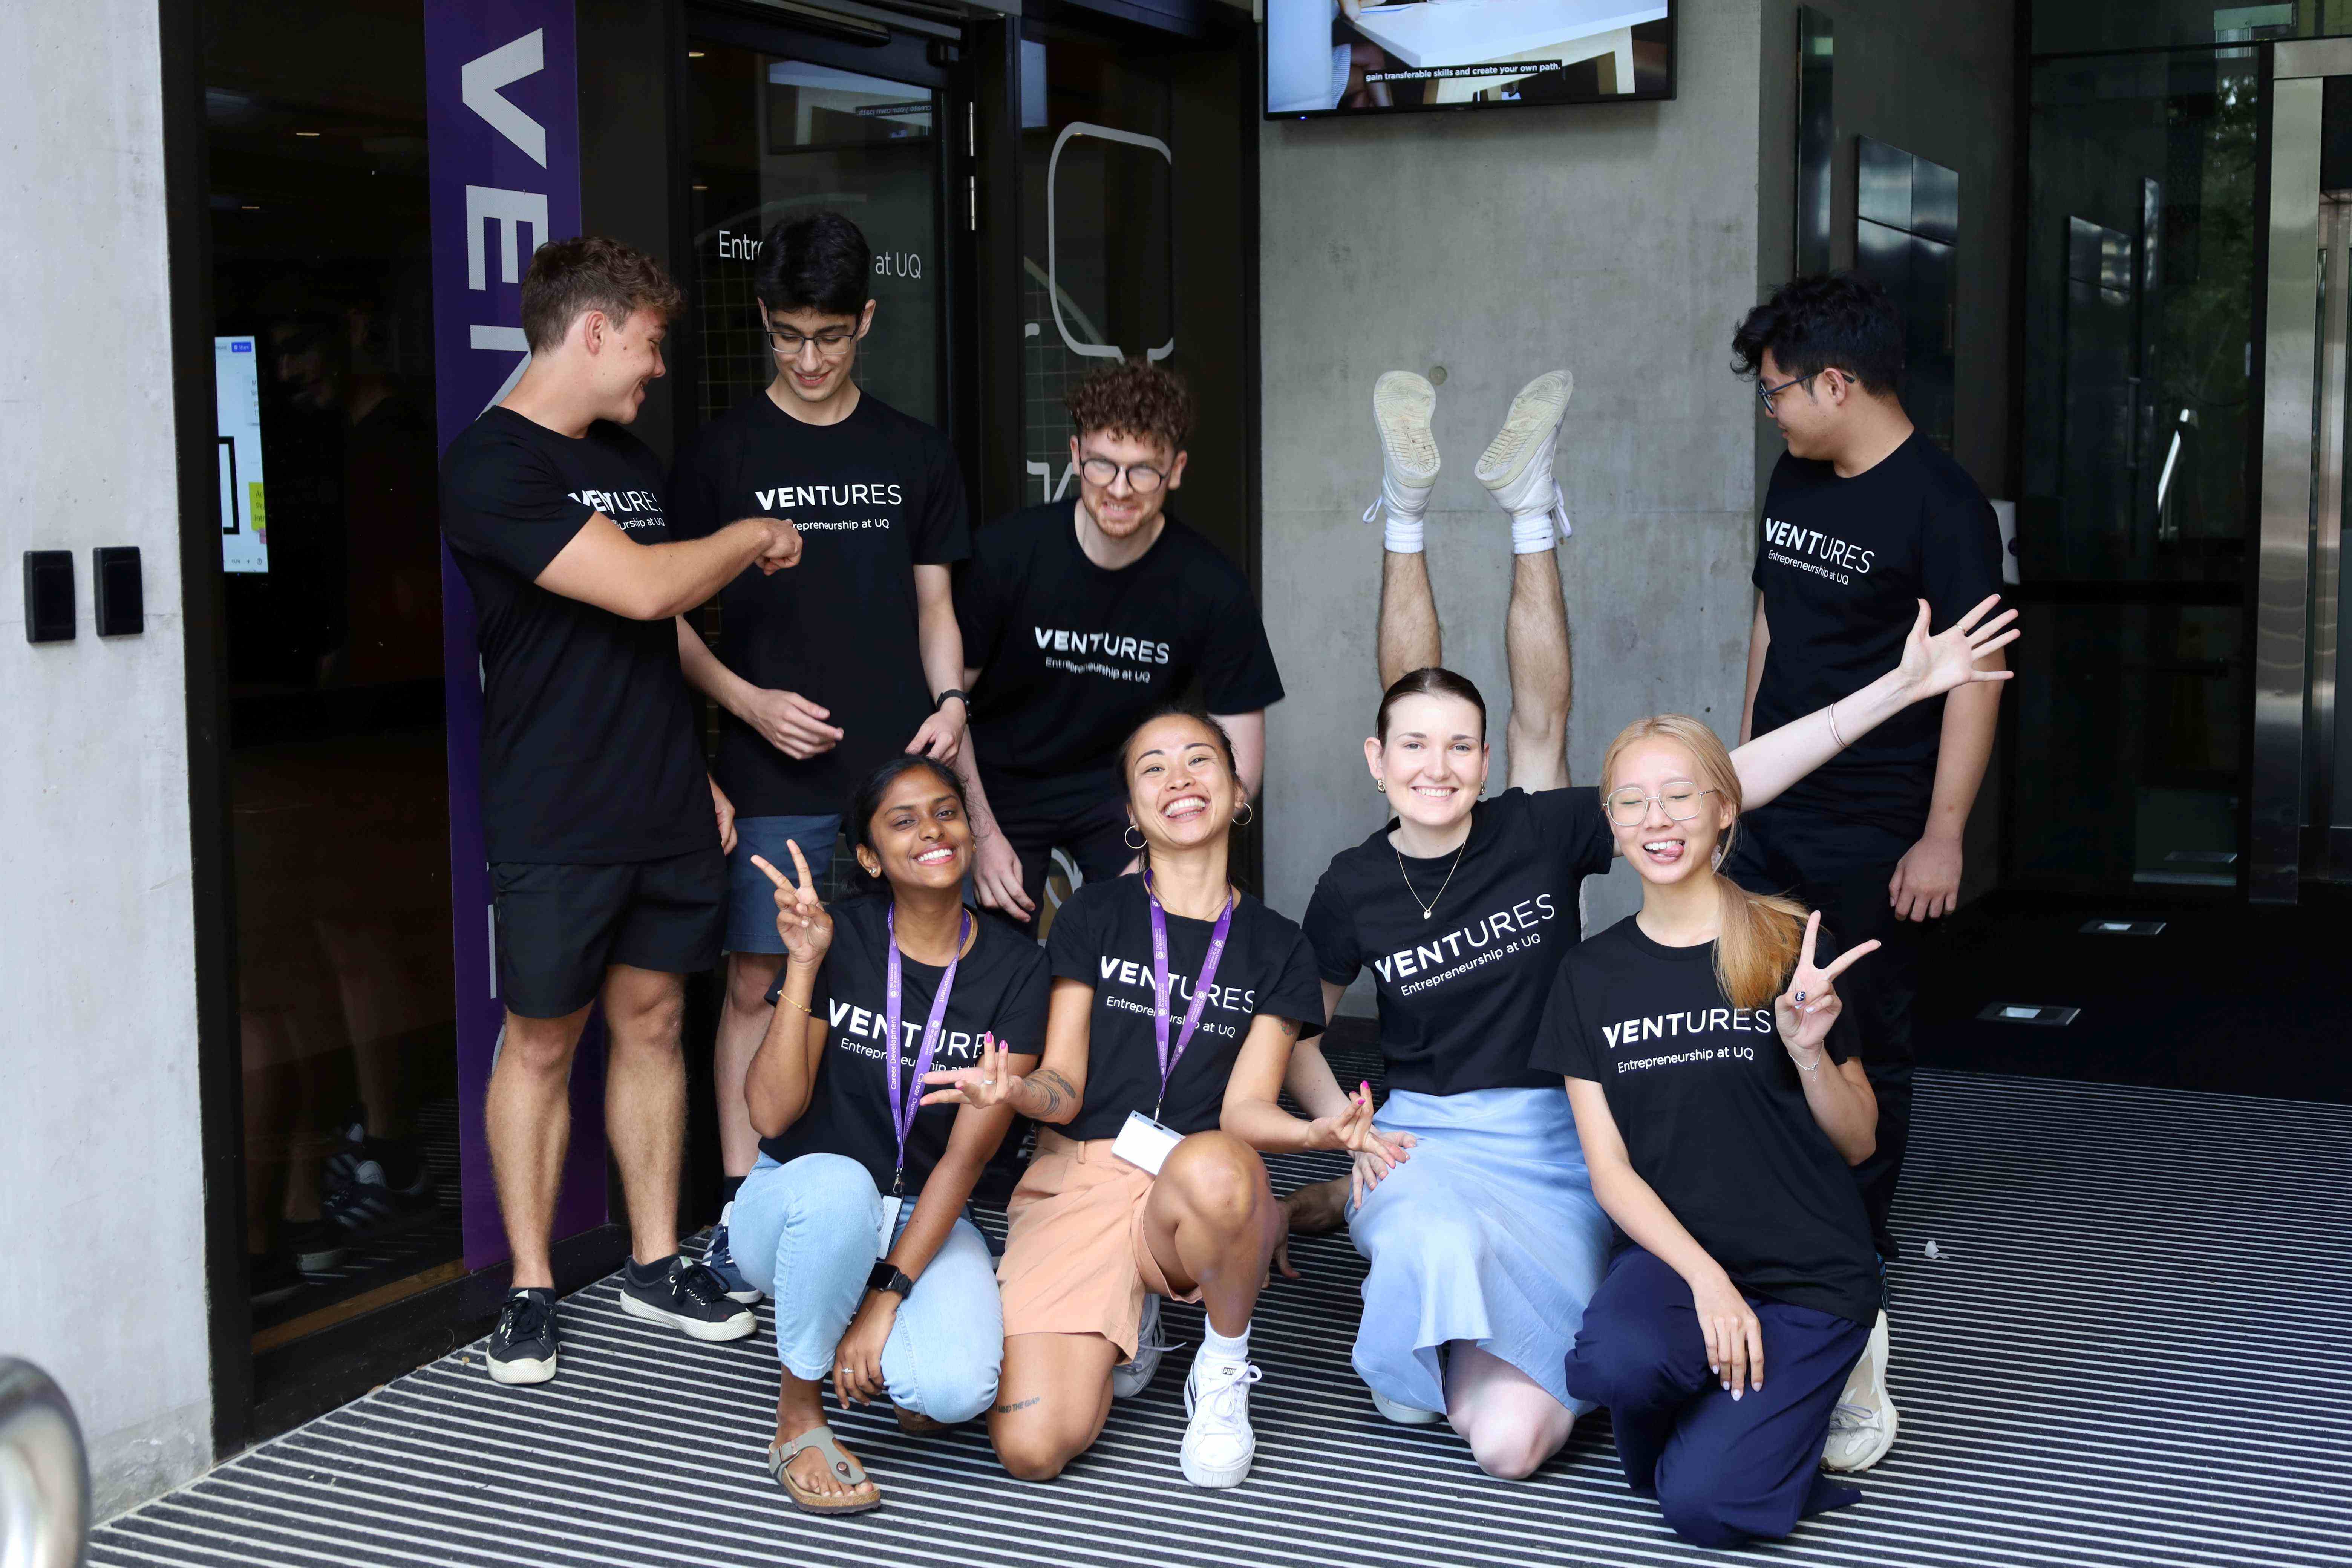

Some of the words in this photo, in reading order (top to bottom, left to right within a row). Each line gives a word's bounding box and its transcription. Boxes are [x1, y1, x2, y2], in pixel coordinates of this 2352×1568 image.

[1366, 73, 1383, 82] gain
[1385, 70, 1432, 80] transferable
[1434, 67, 1453, 77] skills
[1455, 67, 1470, 75] and
[1472, 66, 1498, 74] create
[1500, 66, 1518, 75] your
[1540, 63, 1561, 72] path.
[875, 251, 892, 275] at
[896, 252, 921, 279] UQ
[755, 484, 902, 511] VENTURES
[647, 518, 655, 526] at
[793, 520, 859, 531] repreneurship
[862, 519, 872, 528] at
[874, 518, 890, 529] UQ
[1766, 518, 1875, 573] VENTURES
[1768, 549, 1829, 578] Entrepreneurship
[1829, 571, 1836, 581] at
[1837, 572, 1849, 585] UQ
[1035, 626, 1169, 664] VENTURES
[1122, 669, 1132, 681] at
[1135, 671, 1150, 684] UQ
[1375, 893, 1555, 983] VENTURES
[1400, 948, 1503, 996] Entrepreneurship
[1506, 940, 1520, 954] at
[1521, 933, 1541, 948] UQ
[1101, 956, 1255, 1014] VENTURES
[830, 997, 986, 1059] VENTURE
[1203, 1022, 1214, 1032] at
[1218, 1024, 1236, 1038] UQ
[1602, 1008, 1772, 1049] VENTURES
[1617, 1048, 1713, 1073] Entrepreneurship
[1717, 1046, 1730, 1058] at
[1734, 1046, 1754, 1061] UQ
[914, 1073, 924, 1096] Career
